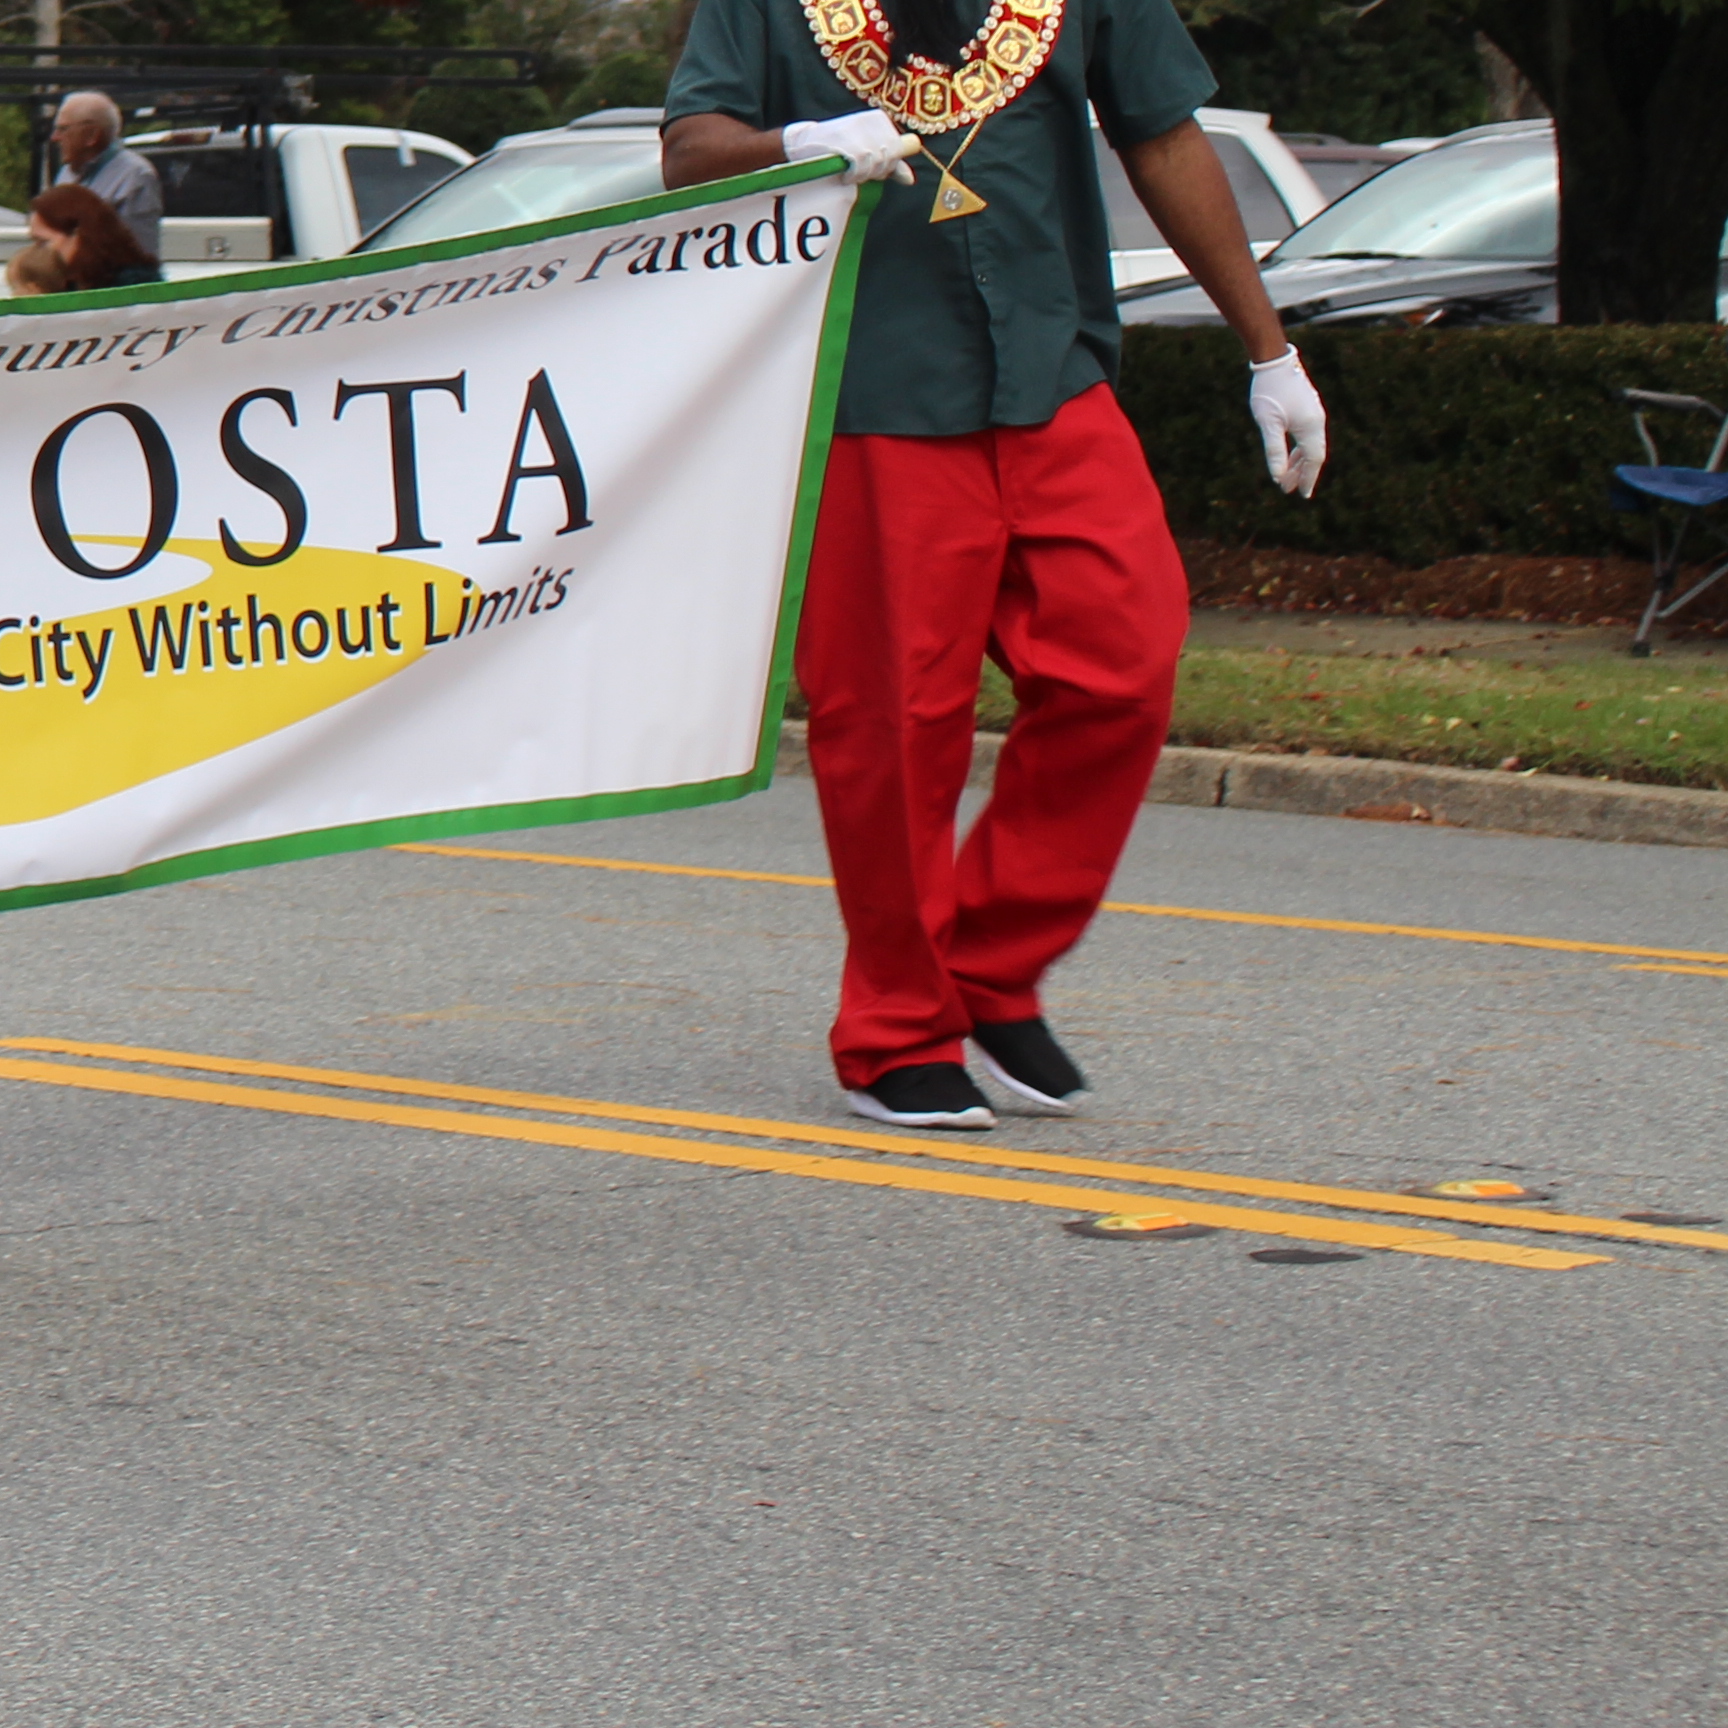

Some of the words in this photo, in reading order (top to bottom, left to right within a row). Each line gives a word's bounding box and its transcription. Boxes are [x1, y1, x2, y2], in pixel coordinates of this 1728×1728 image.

[220, 255, 567, 346] Christmas
[575, 194, 831, 285] Parade
[129, 594, 401, 672] Without
[424, 566, 575, 646] Limits
